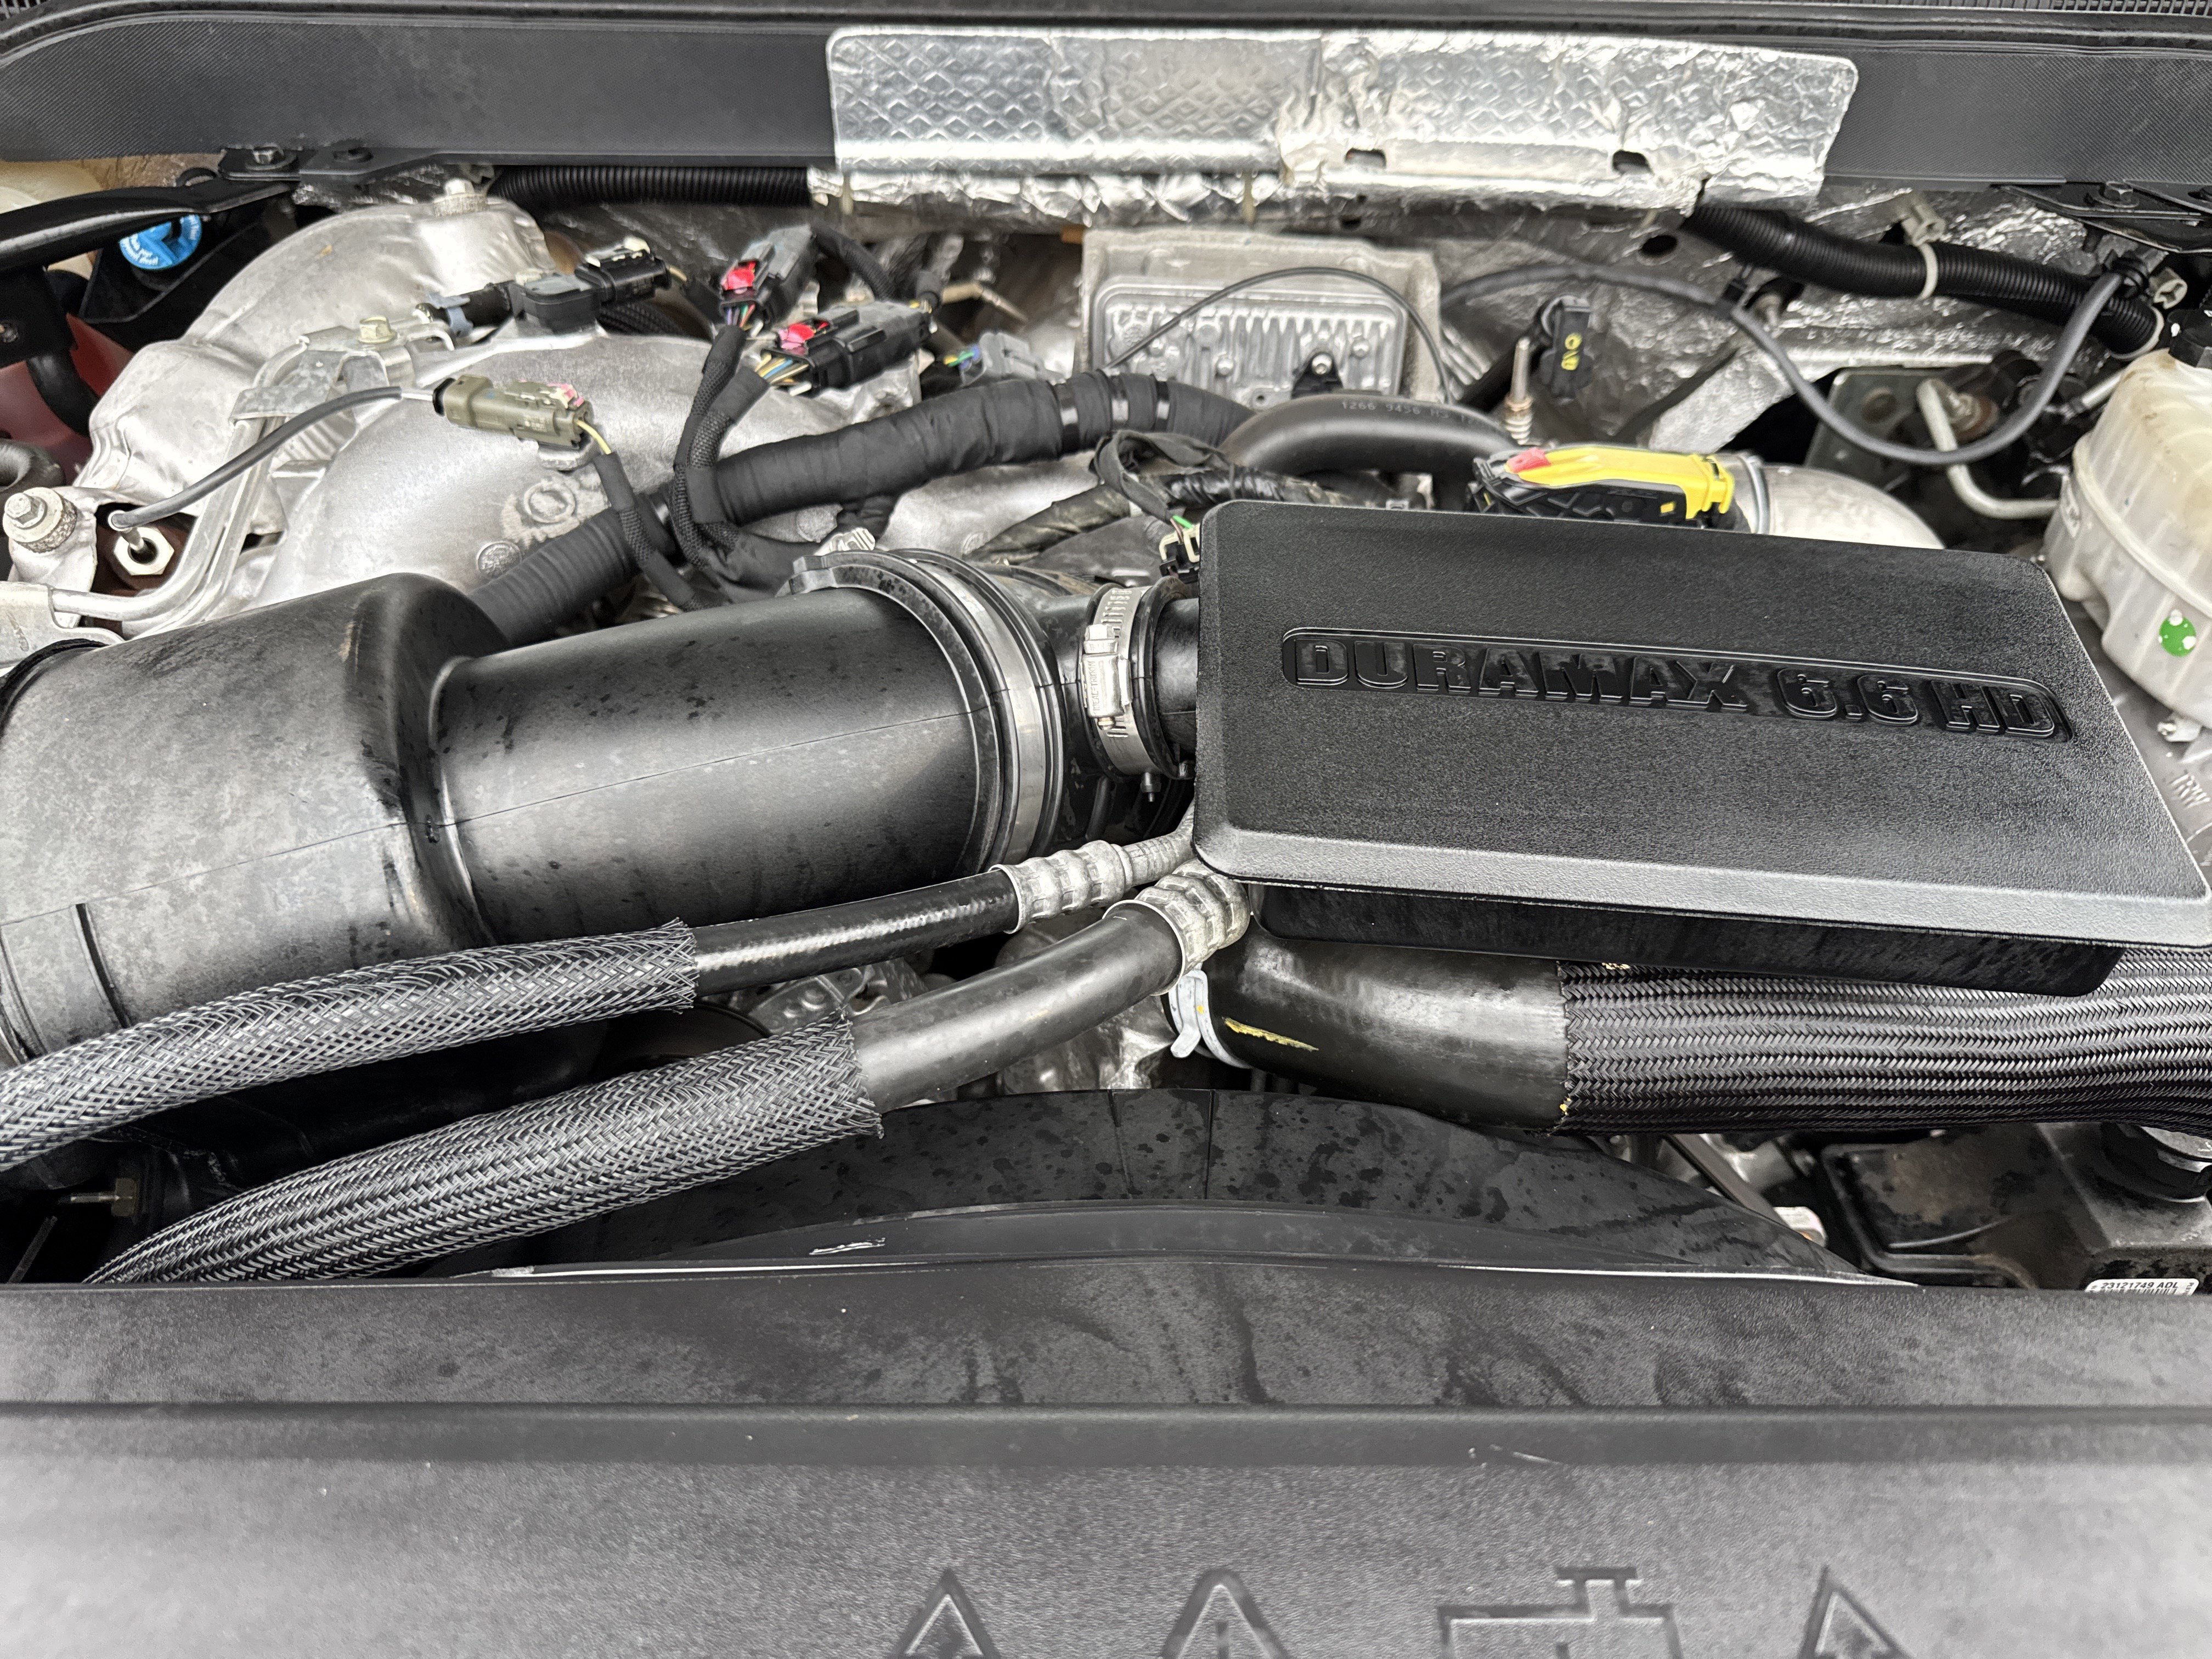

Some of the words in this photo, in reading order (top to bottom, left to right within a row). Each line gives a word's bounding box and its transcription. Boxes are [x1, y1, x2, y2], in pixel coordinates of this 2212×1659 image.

[1295, 638, 1748, 711] DURAMAX
[1776, 667, 1918, 726] 6.6
[1931, 680, 2056, 737] HD
